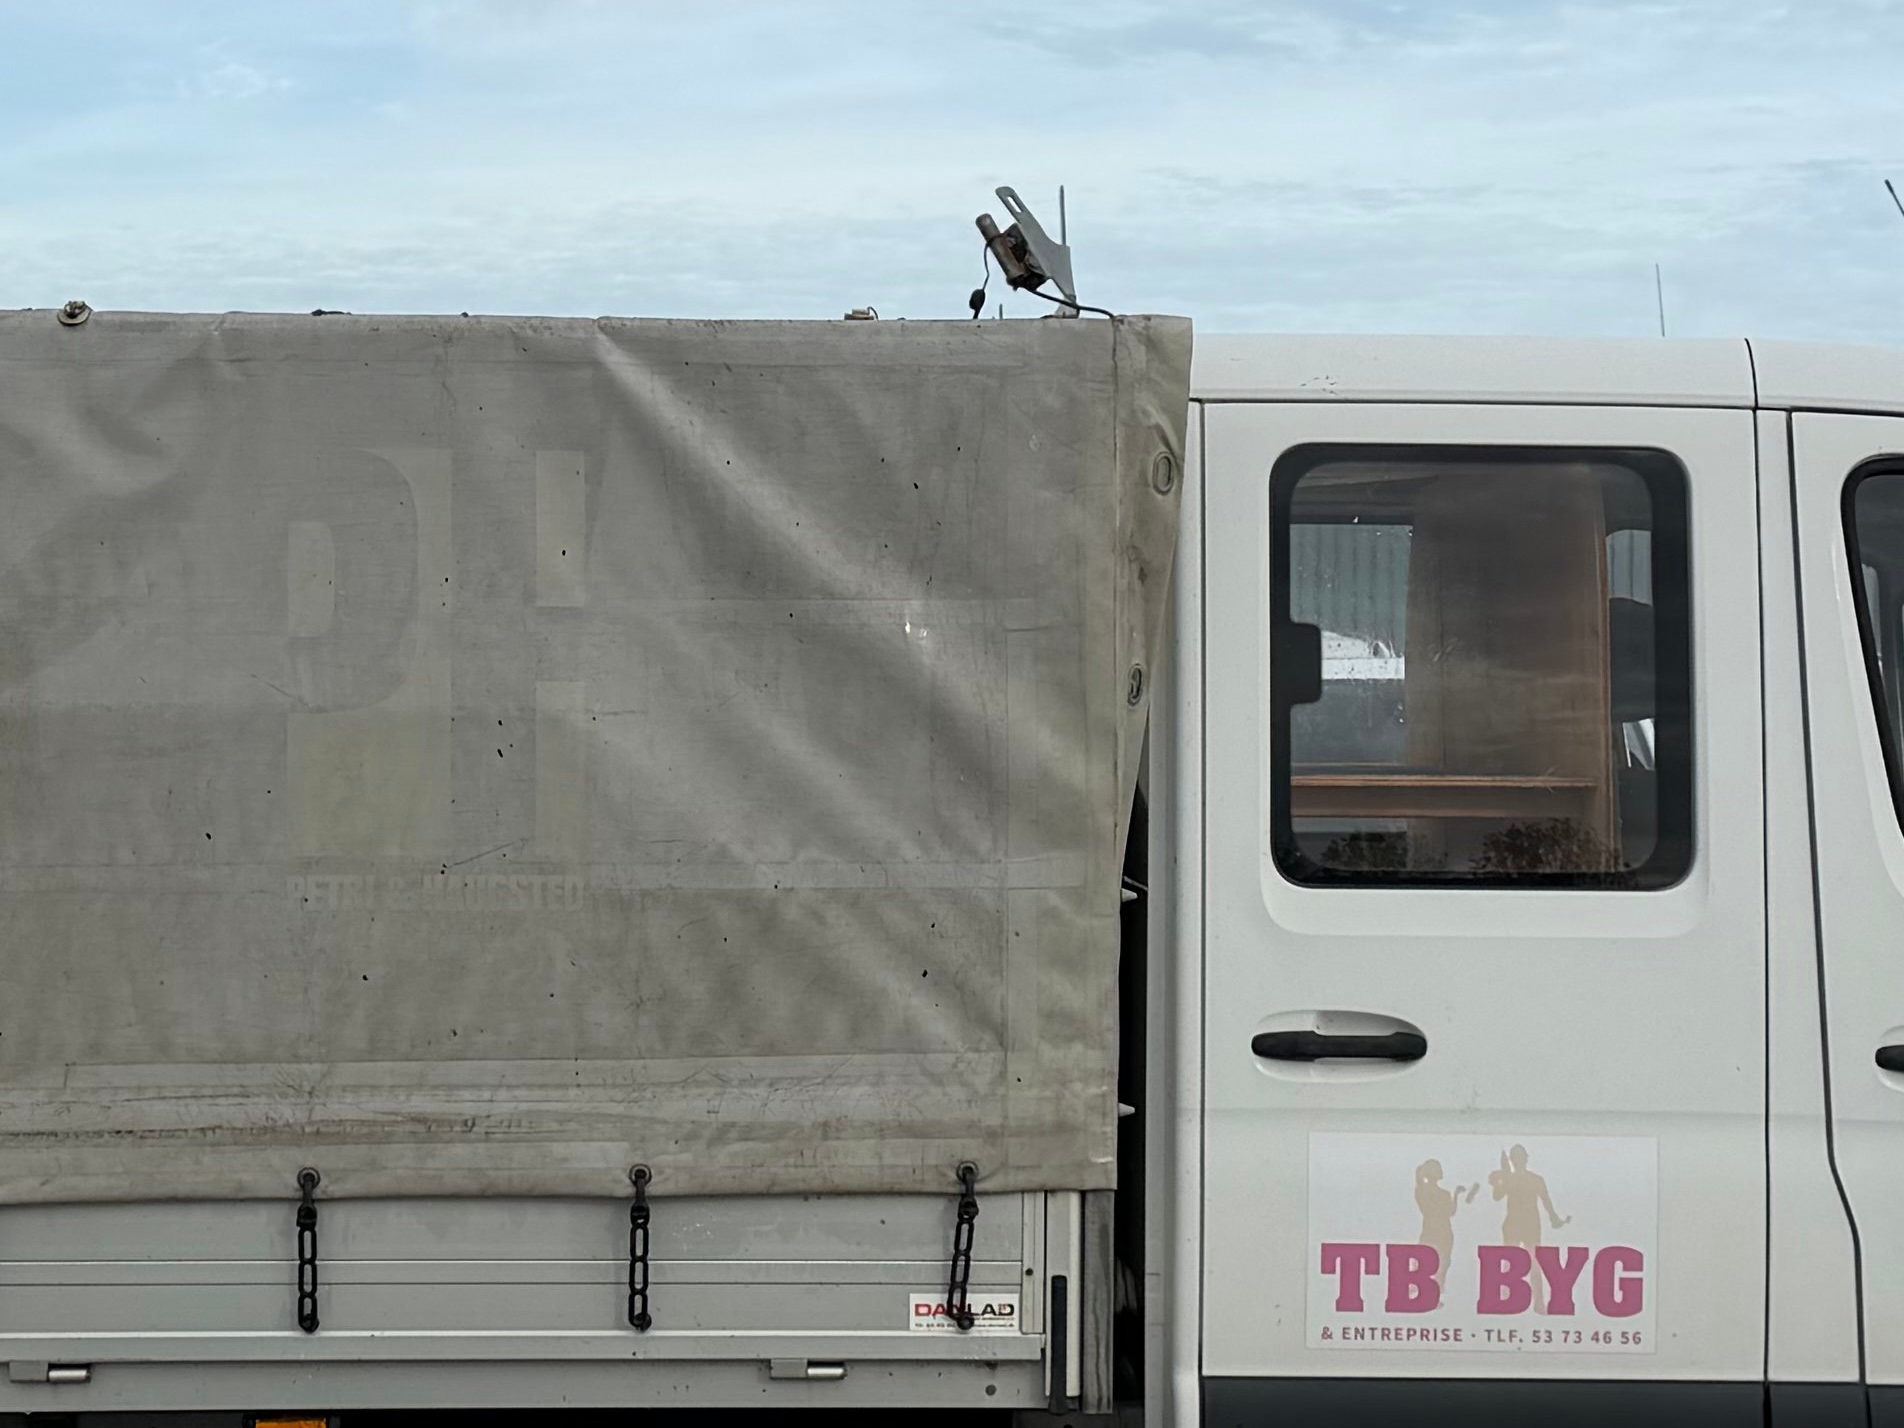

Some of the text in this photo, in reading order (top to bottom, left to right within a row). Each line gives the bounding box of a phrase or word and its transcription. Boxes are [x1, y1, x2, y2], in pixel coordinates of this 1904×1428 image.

[1321, 1243, 1643, 1317] TB BYG
[1321, 1325, 1643, 1346] & ENTREPRISE TLF. 53 73 46 56
